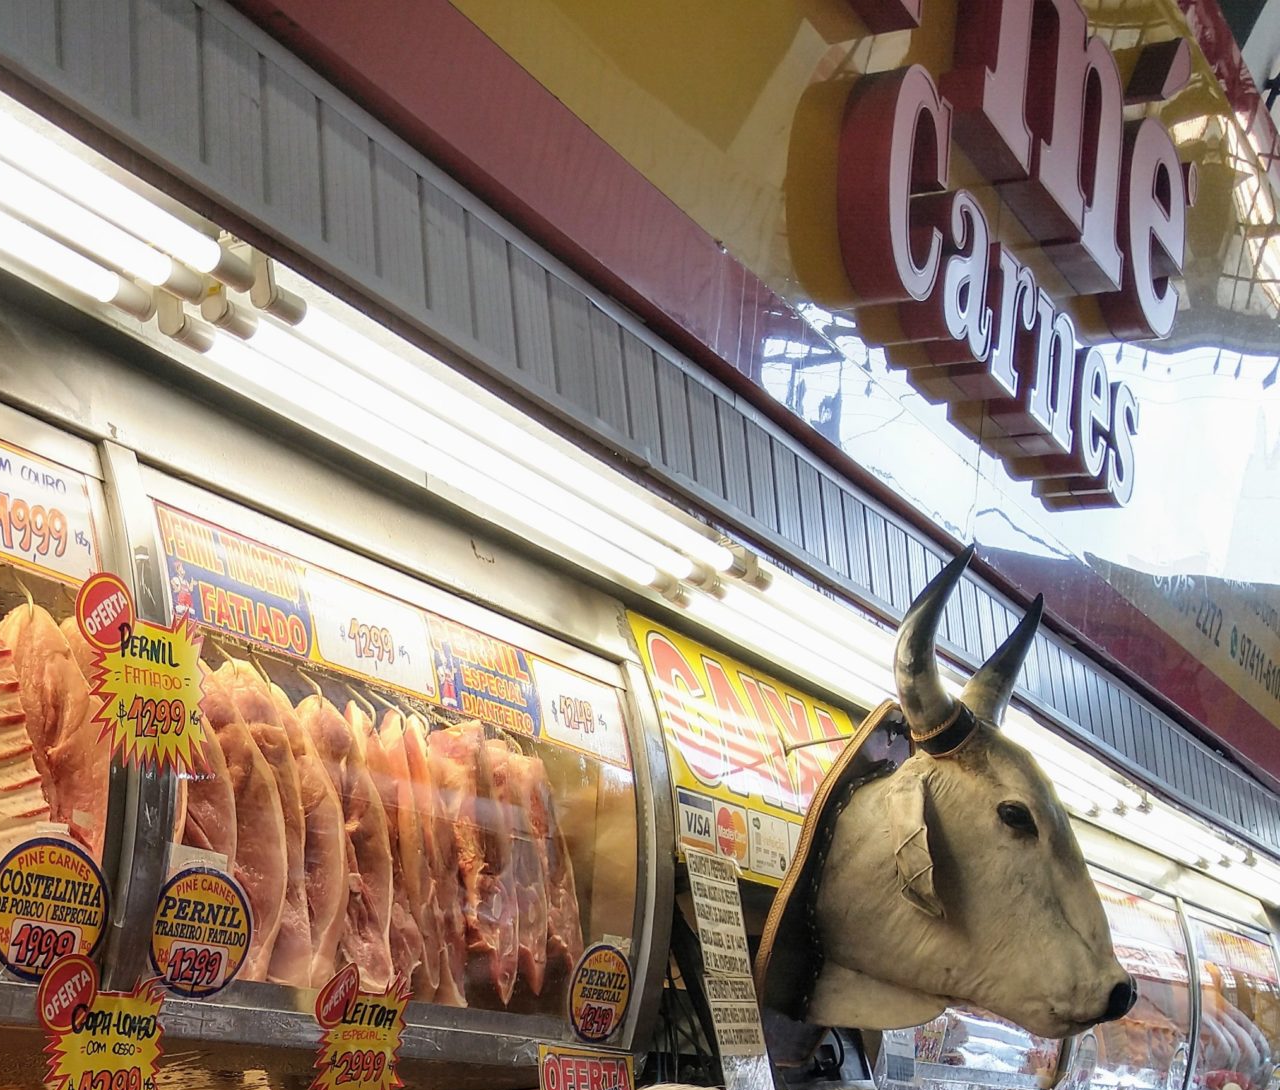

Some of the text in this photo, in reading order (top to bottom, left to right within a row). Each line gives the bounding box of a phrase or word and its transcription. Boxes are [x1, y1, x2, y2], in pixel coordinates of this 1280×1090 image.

[888, 62, 1142, 508] Carnes
[84, 591, 129, 636] OFERTA
[198, 580, 310, 655] FATIADO
[118, 622, 180, 668] PERNIL
[459, 663, 528, 706] ESPECIAL
[460, 691, 535, 735] DIANTEIRO
[685, 809, 711, 838] VISA
[48, 850, 91, 882] CARNES
[0, 868, 102, 908] COSTELINHA
[201, 879, 236, 906] CARNES
[9, 898, 44, 919] PORCO
[160, 895, 242, 929] PERNIL
[155, 920, 201, 941] TRASEIRO
[207, 927, 246, 948] FATIADO
[44, 969, 91, 1021] OFERTA
[322, 975, 356, 1017] OFERTA
[578, 967, 627, 991] PERNIL
[580, 986, 621, 1003] ESPECIAL
[341, 1000, 398, 1030] LEITOA
[342, 1030, 381, 1041] ESPECIAL
